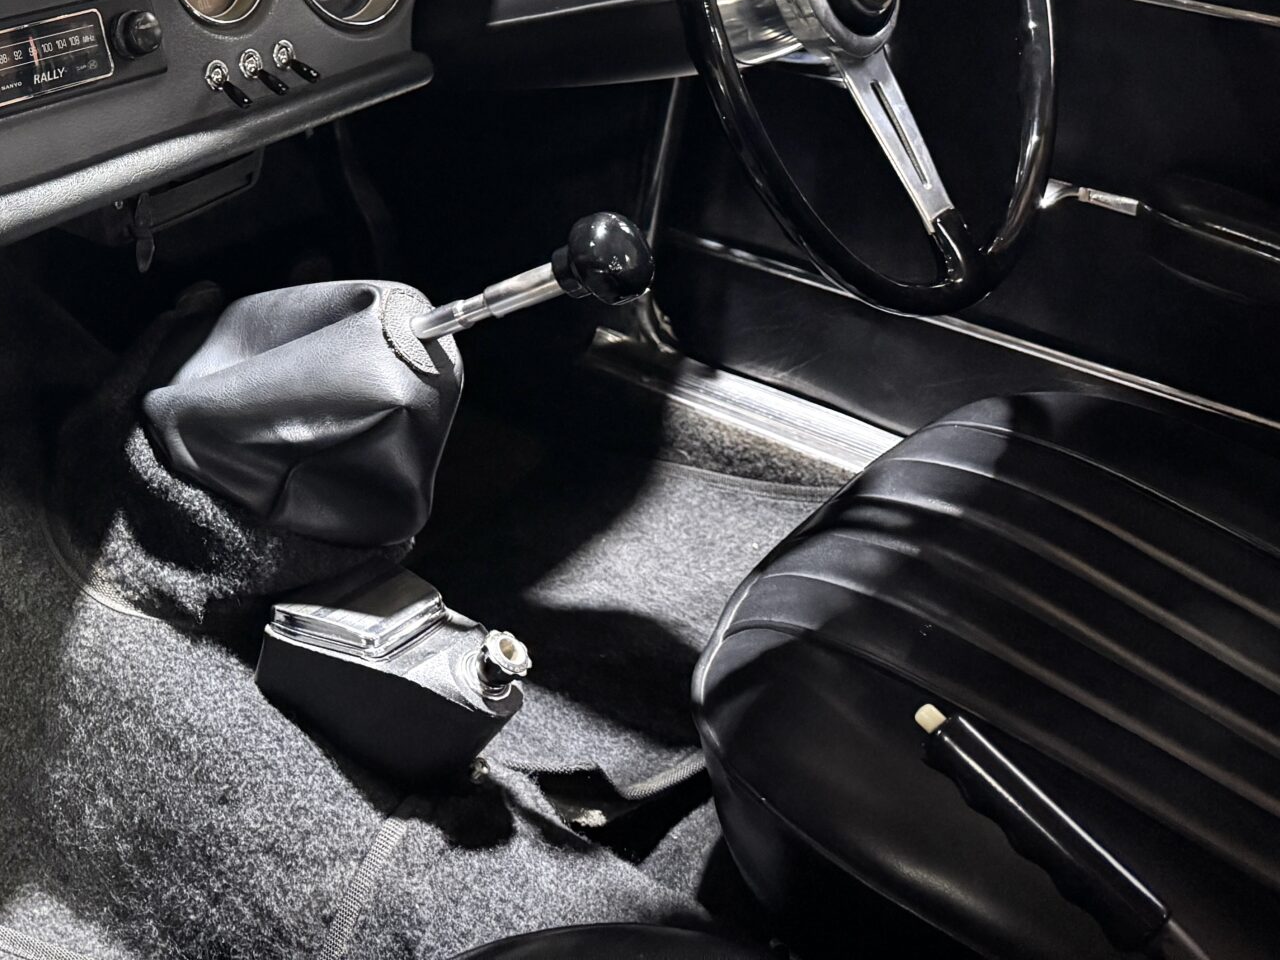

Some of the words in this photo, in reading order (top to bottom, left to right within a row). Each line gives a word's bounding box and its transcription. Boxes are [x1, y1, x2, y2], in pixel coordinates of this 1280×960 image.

[13, 50, 23, 61] 92
[41, 42, 53, 53] 100
[55, 38, 67, 49] 104
[68, 35, 80, 46] 108
[33, 67, 65, 85] RALLY
[1, 81, 23, 91] SANYO
